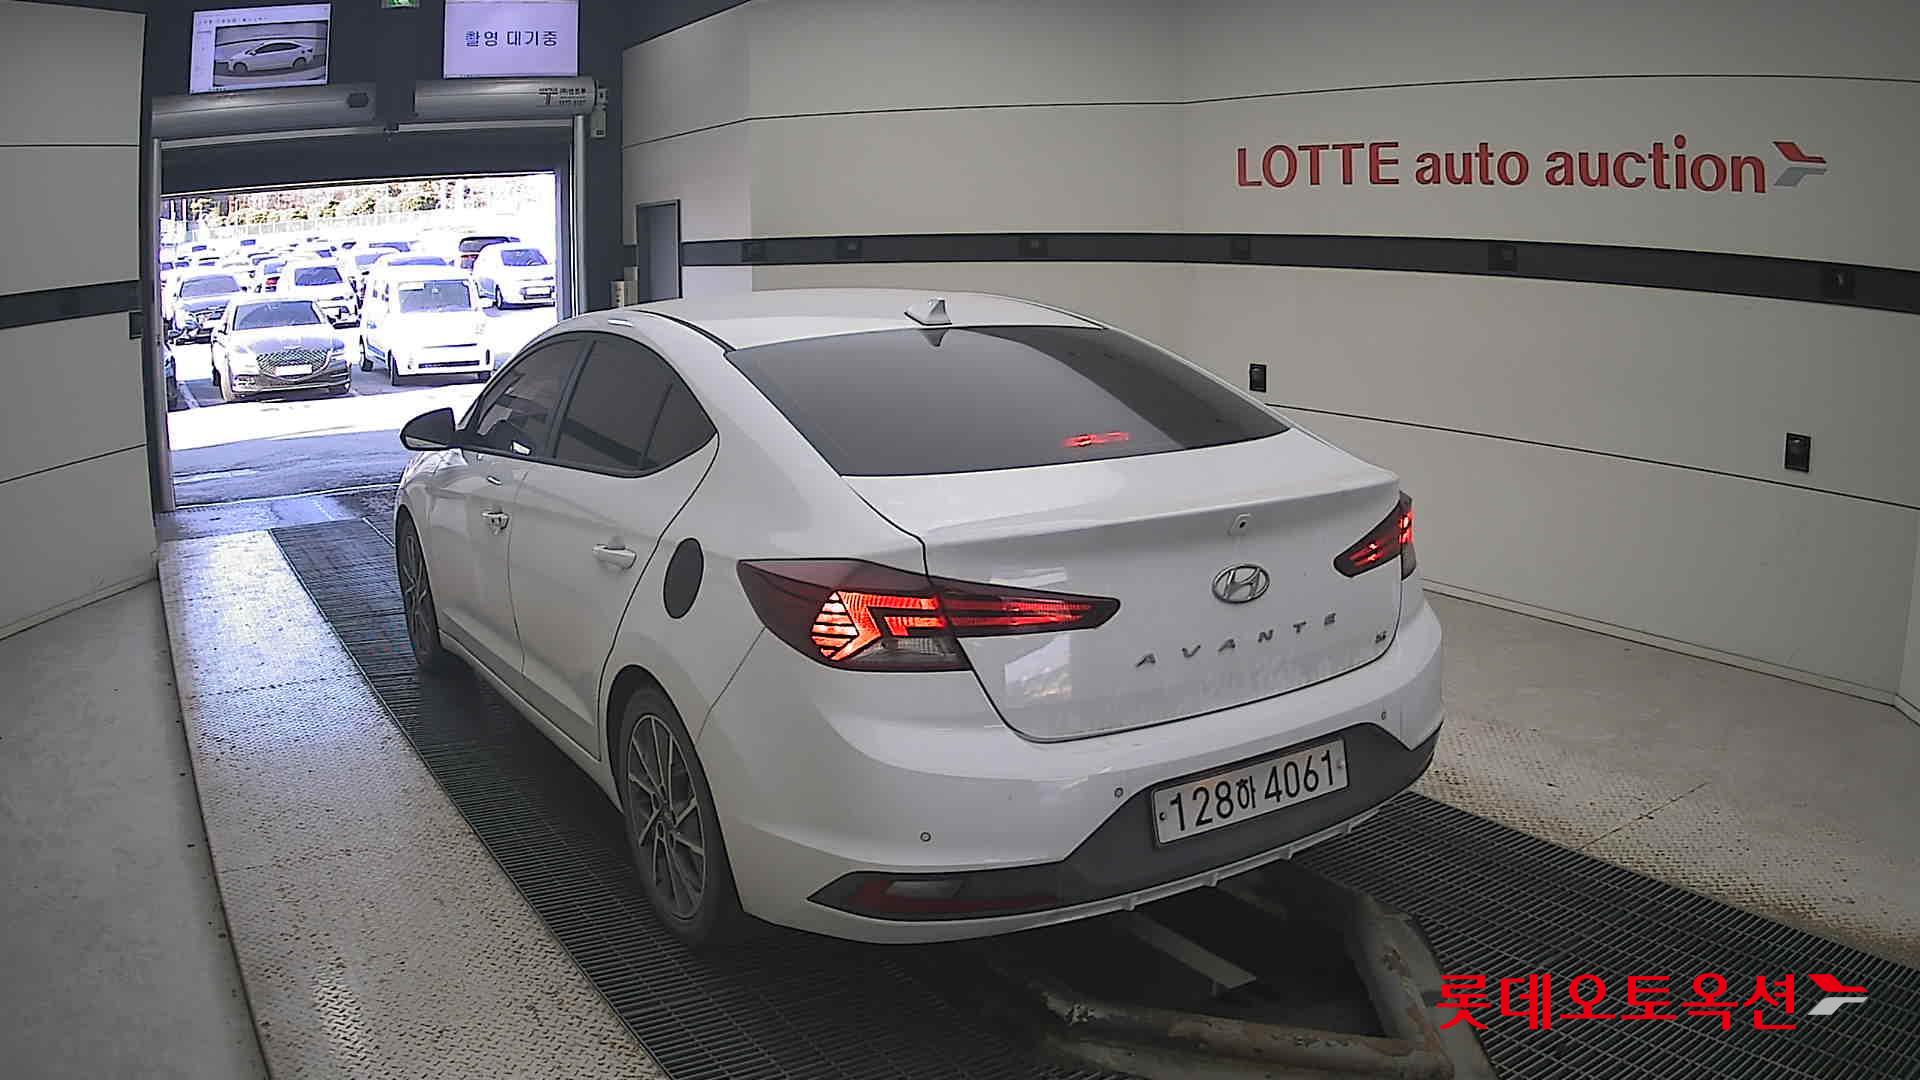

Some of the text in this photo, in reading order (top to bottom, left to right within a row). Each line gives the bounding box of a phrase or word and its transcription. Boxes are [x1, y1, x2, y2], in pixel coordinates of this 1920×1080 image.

[465, 30, 559, 48] 촬영 대기중
[1237, 135, 1766, 193] LOTTE auto auction
[1136, 613, 1337, 667] AVANTE
